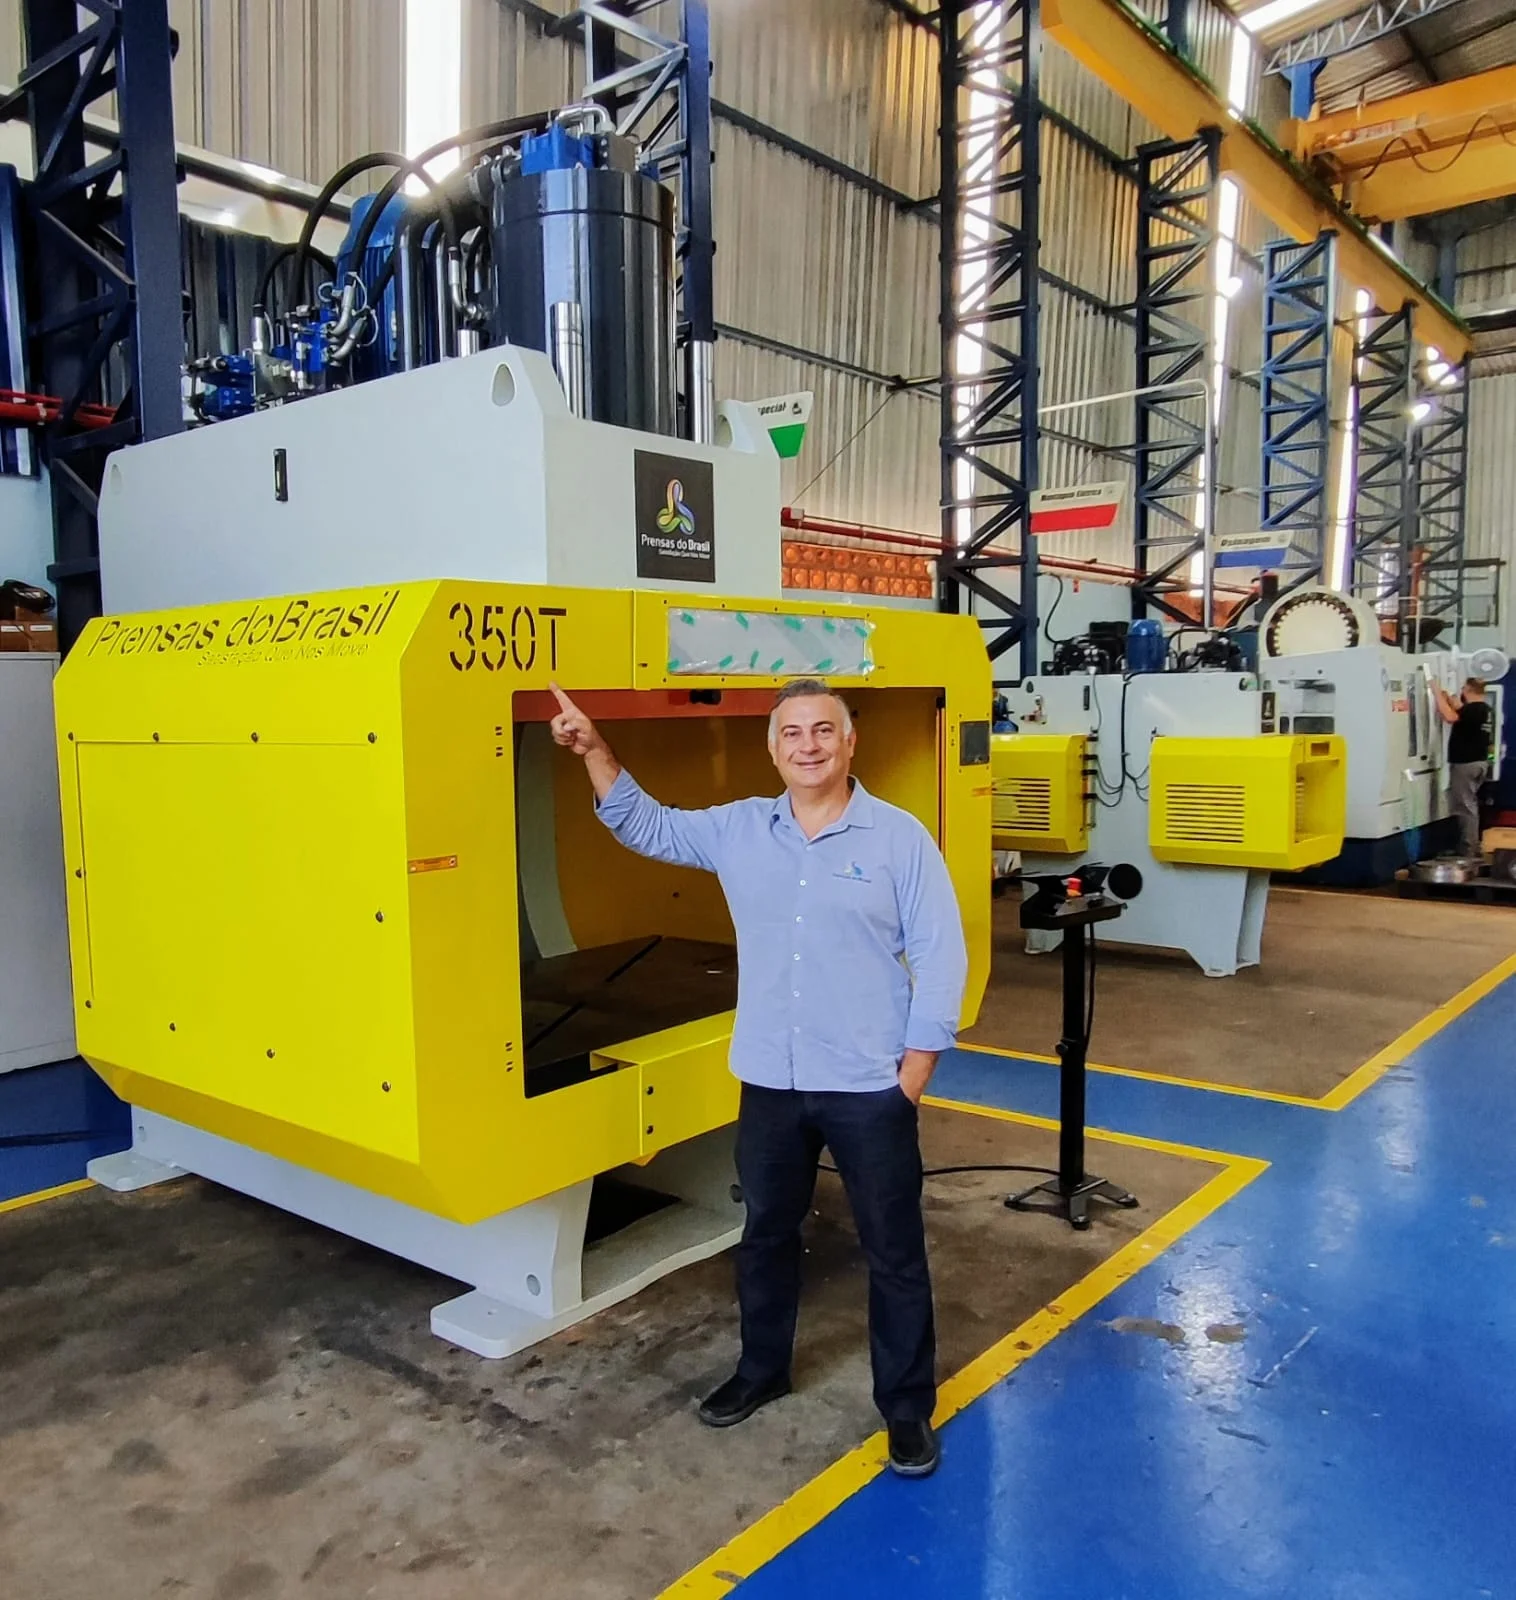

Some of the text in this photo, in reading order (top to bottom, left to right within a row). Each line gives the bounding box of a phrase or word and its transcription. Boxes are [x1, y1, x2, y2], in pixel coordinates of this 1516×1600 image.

[641, 534, 710, 552] Prensas do Brasil
[87, 619, 221, 656] Prensas
[449, 602, 567, 672] 350T
